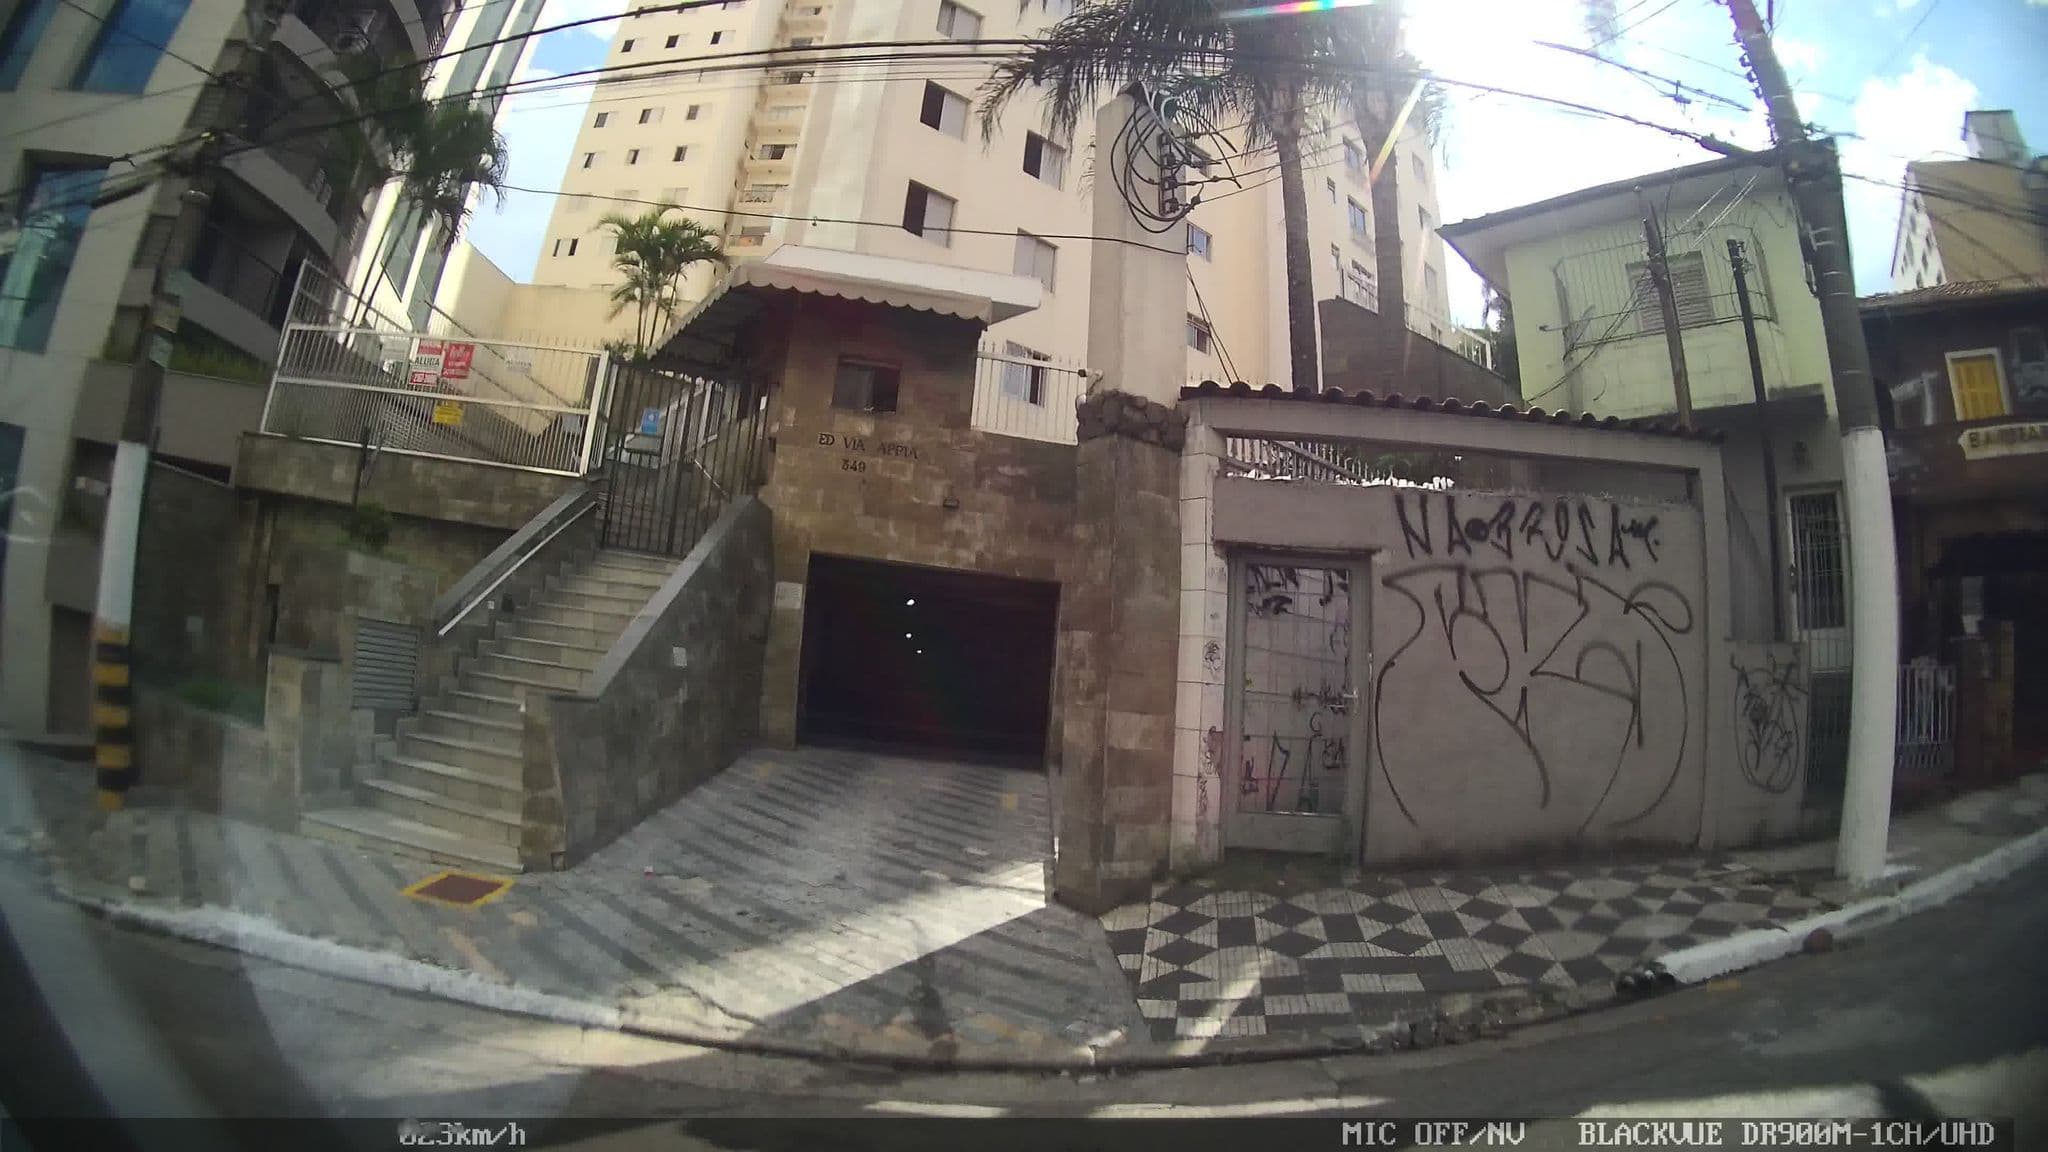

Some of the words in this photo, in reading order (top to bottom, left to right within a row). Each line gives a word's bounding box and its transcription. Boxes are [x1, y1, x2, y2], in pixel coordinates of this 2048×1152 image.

[819, 433, 835, 446] ED
[843, 436, 865, 452] VIA
[878, 442, 918, 460] APPIA
